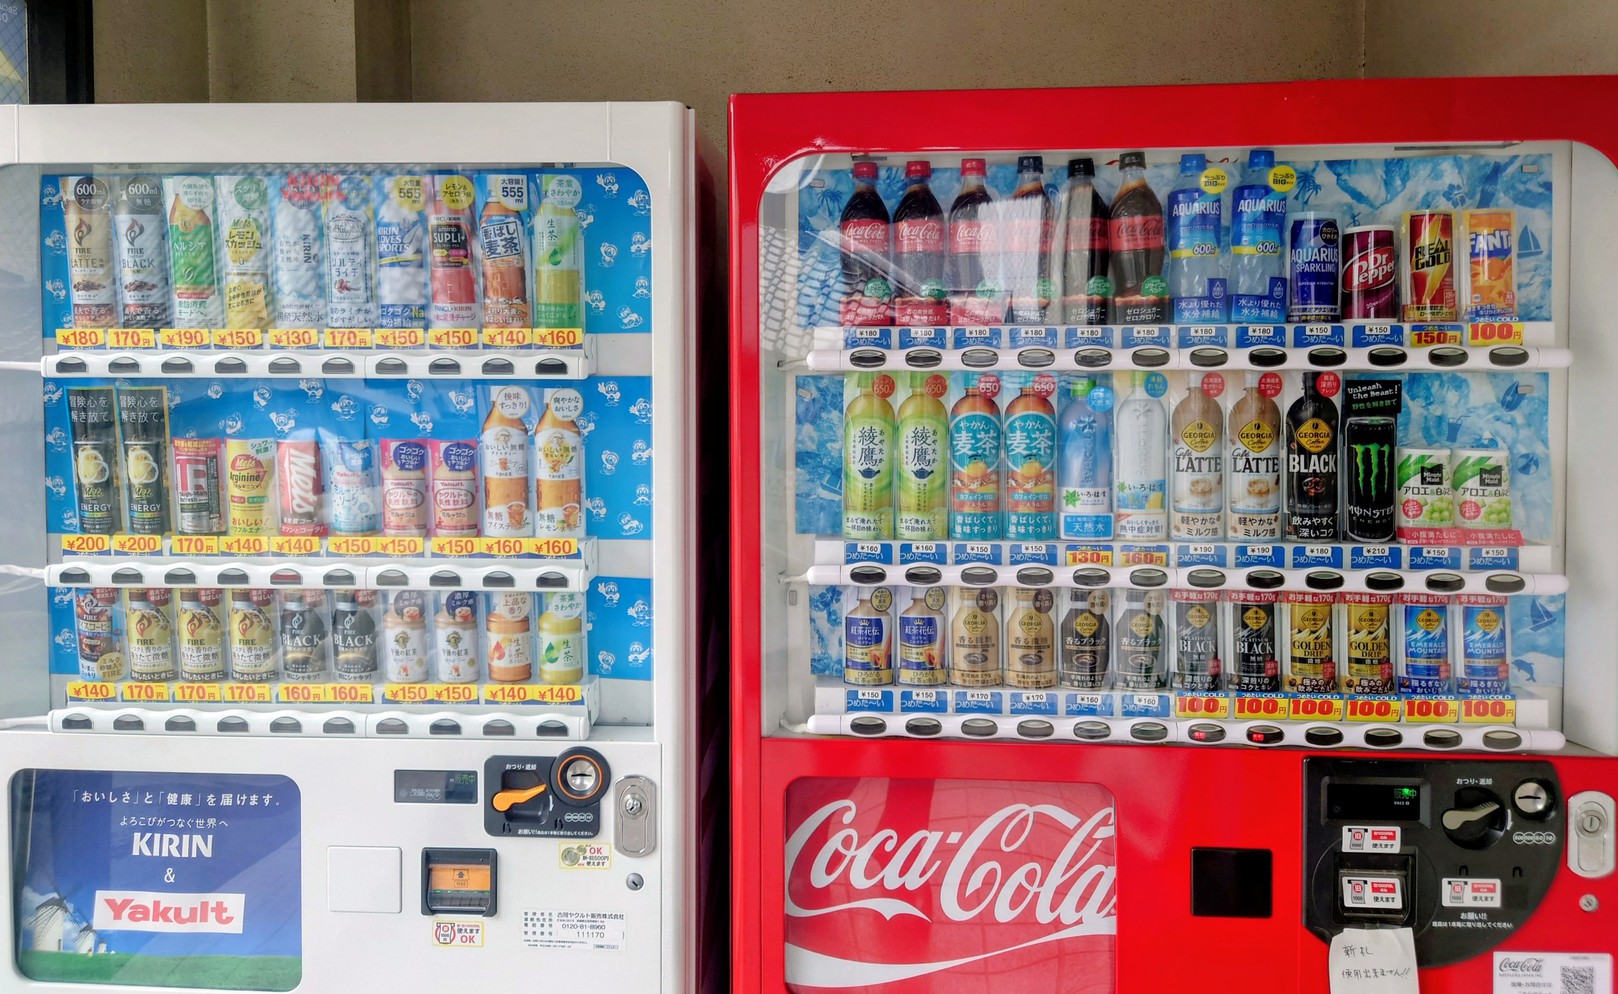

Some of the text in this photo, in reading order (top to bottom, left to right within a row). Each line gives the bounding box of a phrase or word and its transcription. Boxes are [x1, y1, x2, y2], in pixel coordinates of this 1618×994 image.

[399, 188, 421, 198] 555
[502, 187, 523, 197] 555
[1173, 202, 1220, 216] AQUARIUS
[1238, 200, 1286, 212] AQUARIUS
[483, 226, 516, 240] 香ばし
[548, 219, 557, 241] 生茶
[846, 223, 885, 240] Coca-Cola
[900, 223, 940, 240] Coca-Cola
[303, 234, 311, 263] KIRIN
[486, 242, 518, 257] 麦茶
[1416, 239, 1449, 258] REAL
[1291, 249, 1338, 262] AQUARIUS
[1370, 252, 1388, 268] Dr
[123, 259, 155, 268] BLACK
[1296, 263, 1335, 273] SPARKLING
[1416, 254, 1450, 270] GOLD
[1179, 301, 1223, 309] 水より優れた
[1239, 299, 1281, 308] 水より優れた
[1182, 310, 1220, 318] 水分補給
[1241, 309, 1278, 317] 水分補給
[63, 332, 98, 344] ¥180
[115, 332, 150, 345] 170円
[167, 332, 203, 344] ¥190
[219, 332, 255, 344] ¥150
[275, 332, 311, 344] ¥130
[330, 331, 366, 345] 170円
[381, 331, 418, 344] ¥150
[489, 331, 525, 344] ¥140
[540, 331, 576, 344] ¥160
[1415, 332, 1457, 343] 150円
[1471, 325, 1521, 340] 100円
[979, 383, 999, 391] 650
[1034, 383, 1054, 391] 650
[1348, 383, 1382, 394] Unleash
[70, 396, 107, 408] 冒険心を
[120, 396, 157, 408] 冒険心を
[553, 396, 580, 404] 爽やかな
[71, 410, 115, 422] 解き放て。
[121, 410, 164, 422] 解き放て。
[858, 427, 878, 466] 綾鷹
[911, 427, 931, 466] 綾鷹
[953, 432, 996, 455] 麦茶
[1007, 432, 1051, 455] 麦茶
[1176, 457, 1221, 472] LATTE
[1233, 457, 1278, 472] LATTE
[1291, 454, 1336, 473] BLACK
[81, 503, 111, 511] ENERGY
[131, 503, 161, 511] ENERGY
[1181, 516, 1216, 525] 軽やかな
[1238, 516, 1273, 525] 軽やかな
[1292, 516, 1333, 525] 飲みやすく
[955, 525, 997, 533] 後味すっきり
[1009, 525, 1052, 533] 後味すっきり
[1073, 523, 1104, 532] 天然水
[1186, 528, 1218, 536] ミルク感
[1244, 528, 1275, 537] ミルク感
[1299, 528, 1333, 537] 深いコク
[1411, 531, 1456, 539] 小腹満たしに
[68, 537, 104, 550] ¥200
[178, 538, 213, 553] 170円
[226, 538, 262, 551] ¥140
[334, 539, 370, 553] ¥150
[487, 540, 522, 553] ¥160
[1071, 552, 1108, 562] 130円
[1123, 553, 1162, 564] 160円
[850, 625, 880, 635] 紅茶花伝
[905, 626, 934, 635] 紅茶花伝
[283, 634, 321, 644] BLACK
[334, 634, 373, 644] BLACK
[563, 640, 572, 662] 生茶
[1180, 640, 1216, 652] BLACK
[1237, 641, 1273, 654] BLACK
[1293, 641, 1330, 650] GOLDEN
[1351, 641, 1388, 650] GOLDEN
[73, 685, 109, 697] ¥140
[128, 685, 163, 699] 170円
[229, 685, 265, 700] 170円
[284, 686, 320, 700] 160円
[391, 686, 427, 700] ¥150
[490, 687, 526, 700] ¥140
[1179, 699, 1226, 713] 100円
[1464, 702, 1513, 717] 100円
[73, 790, 279, 806] 「おいしさ」と「健康」を届けます。
[120, 817, 229, 828] よろこびがつなぐ世界へ
[132, 832, 213, 858] KIRIN
[785, 799, 1116, 925] Coca-Cola
[164, 868, 175, 882] &
[104, 899, 234, 925] Yakult
[1343, 945, 1373, 957] 新札
[1499, 958, 1544, 972] Coca-Cola
